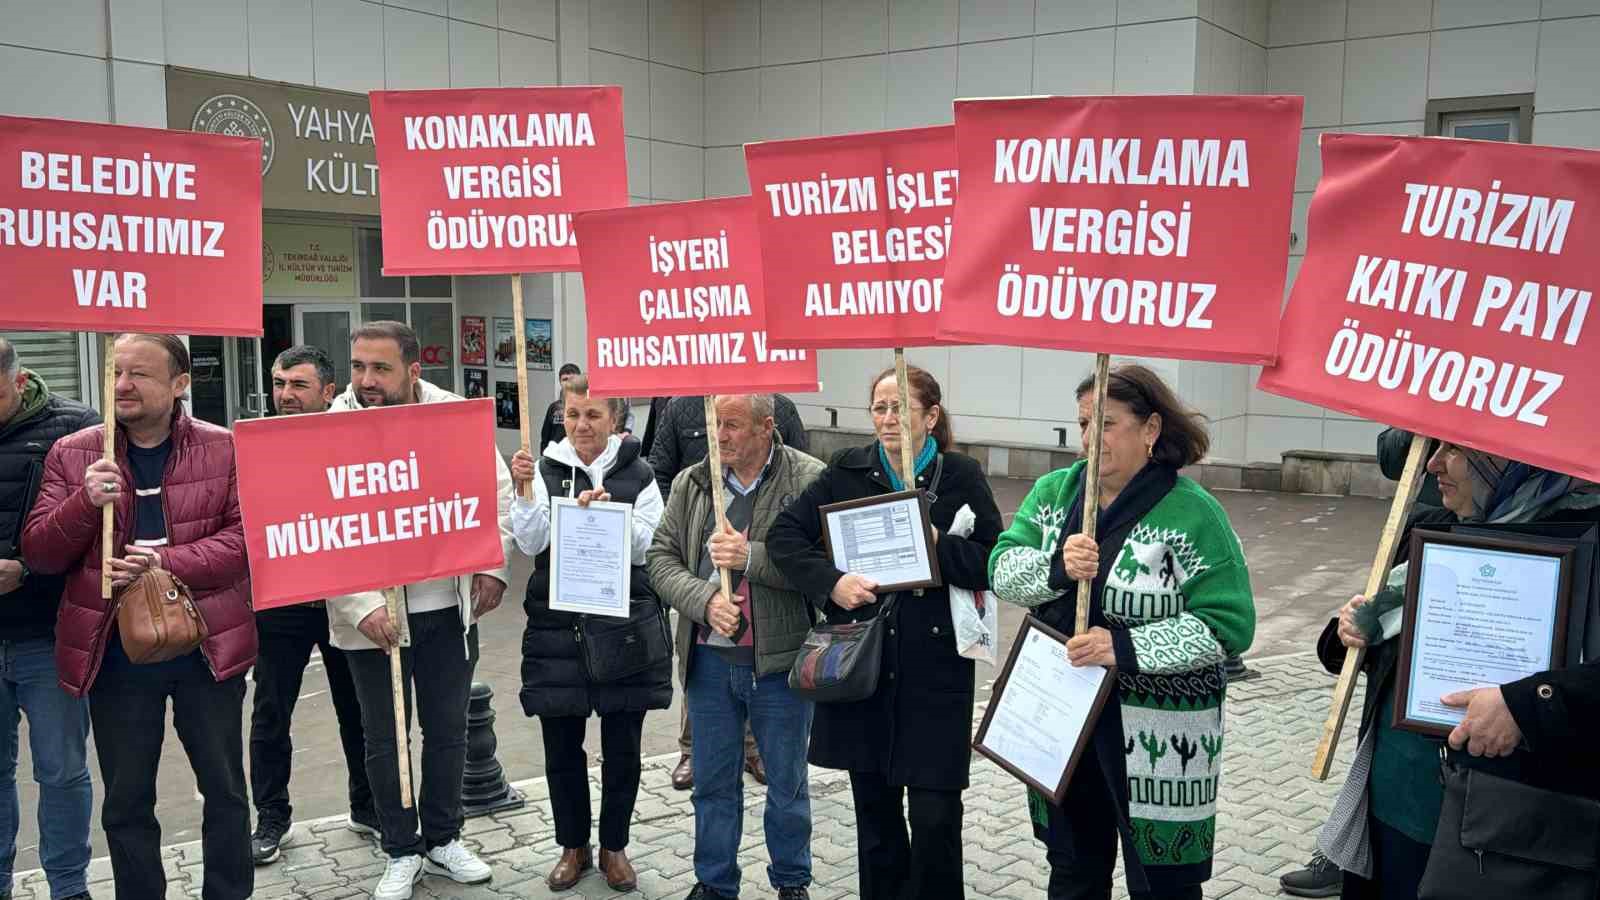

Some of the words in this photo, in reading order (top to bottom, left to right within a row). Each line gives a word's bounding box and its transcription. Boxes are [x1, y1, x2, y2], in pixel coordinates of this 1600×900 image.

[287, 102, 377, 145] YAHYA
[405, 113, 596, 150] KONAKLAMA
[21, 151, 196, 201] BELEDİYE
[307, 152, 379, 195] KÜLT
[443, 157, 562, 200] VERGİSİ
[994, 137, 1250, 188] KONAKLAMA
[764, 172, 878, 217] TURİZM
[1401, 179, 1575, 255] TURİZM
[0, 207, 225, 258] RUHSATIMIZ
[649, 229, 729, 277] İŞYERİ
[831, 216, 953, 265] BELGESİ
[1029, 200, 1192, 257] VERGİSİ
[73, 268, 147, 309] VAR
[639, 283, 752, 325] ÇALIŞMA
[996, 264, 1217, 329] ÖDÜYORUZ
[1345, 254, 1468, 322] KATKI
[1471, 275, 1593, 346] PAYI
[596, 332, 747, 368] RUHSATIMIZ
[1324, 318, 1565, 428] ÖDÜYORUZ
[326, 450, 420, 500] VERGİ
[265, 491, 481, 559] MÜKELLEFİYİZ
